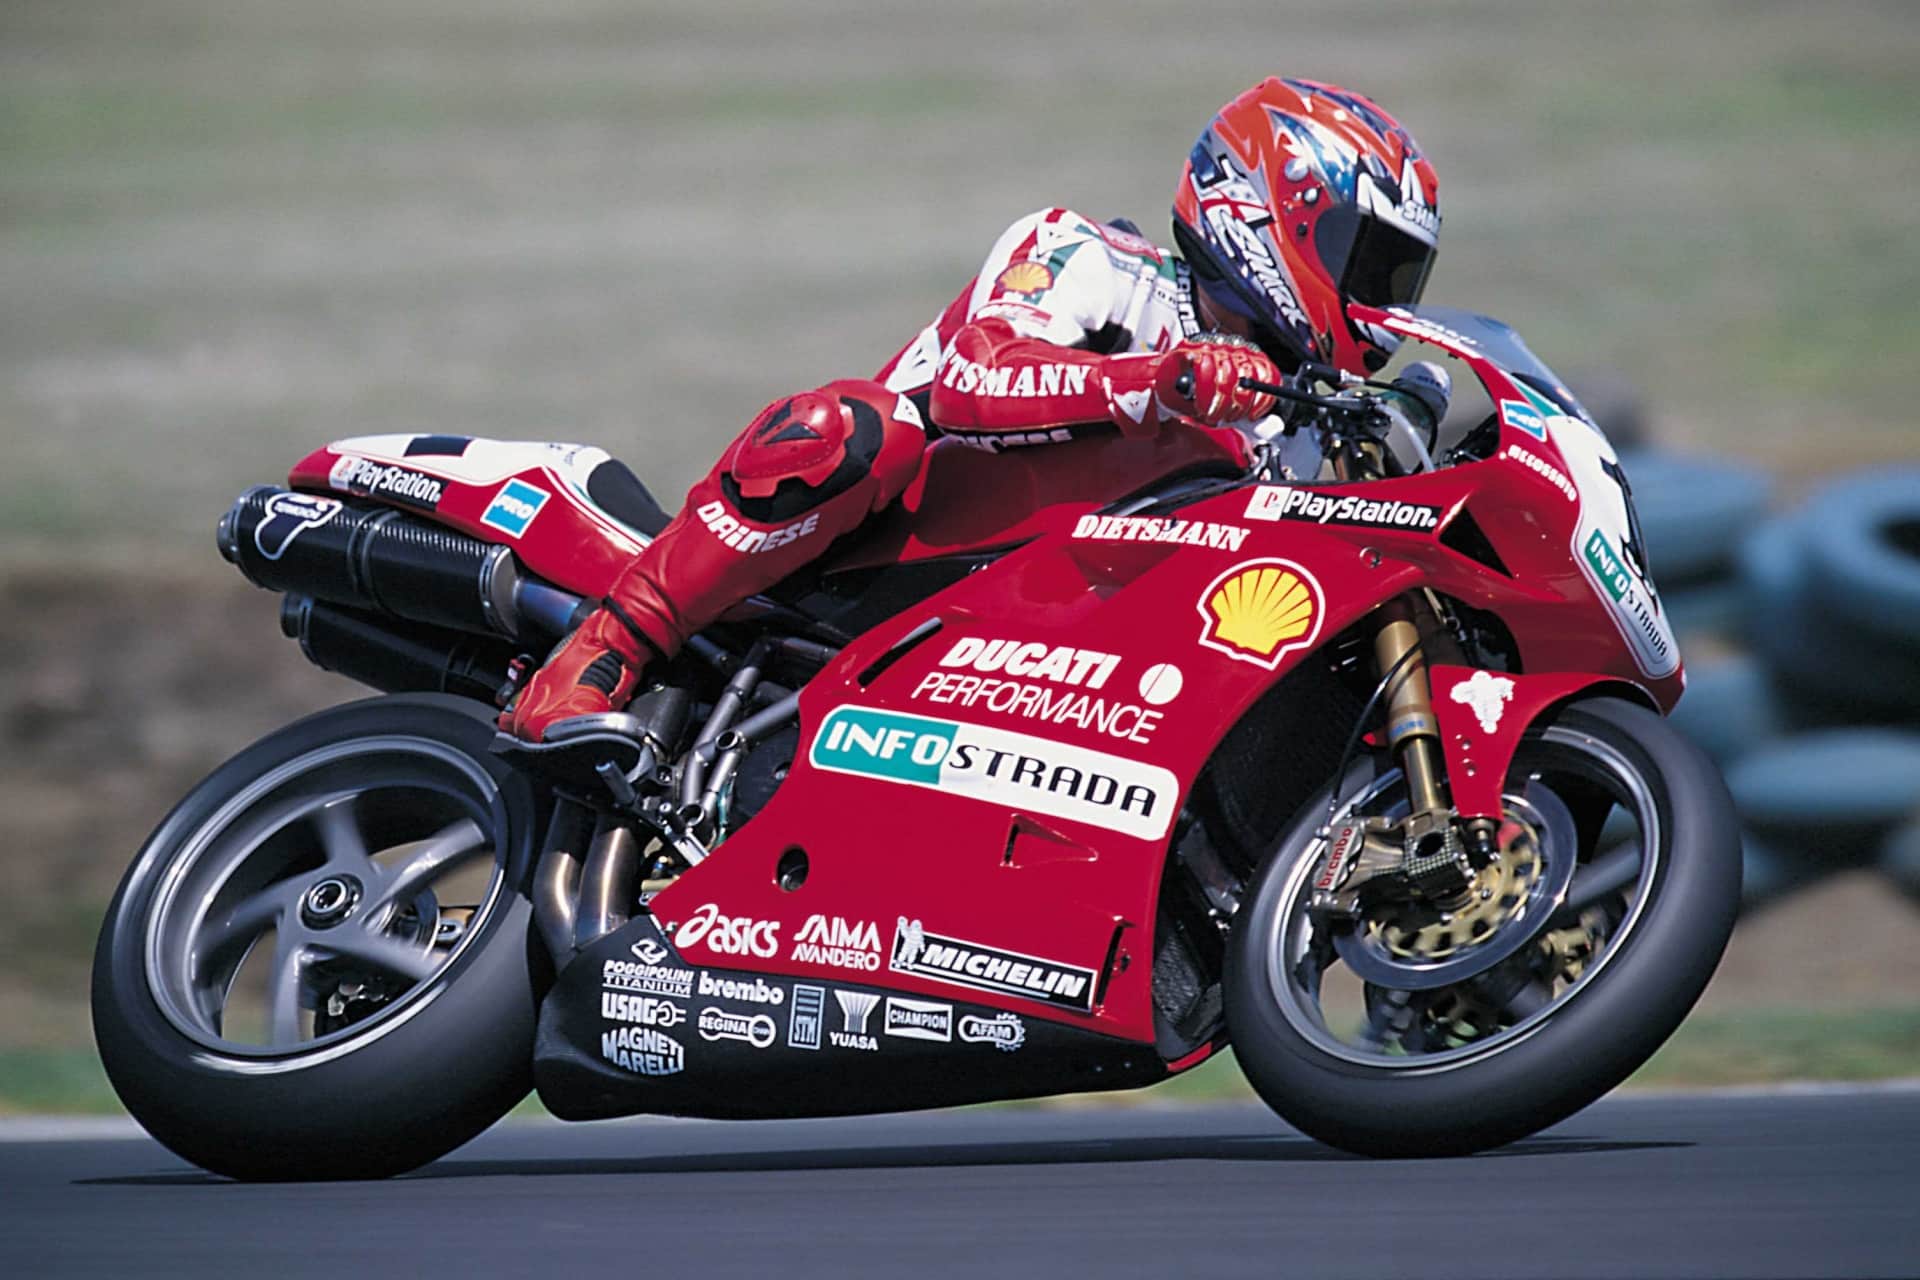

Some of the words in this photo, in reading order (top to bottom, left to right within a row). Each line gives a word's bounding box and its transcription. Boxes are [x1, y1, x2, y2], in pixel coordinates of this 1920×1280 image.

[696, 500, 820, 553] DAINESE
[1072, 514, 1250, 552] DIETSMANN
[939, 637, 1122, 688] DUCATI
[911, 671, 1164, 744] PERFORMANCE
[793, 914, 882, 952] SAIMA
[603, 959, 694, 983] POGGIPOLINI
[791, 945, 880, 971] AVANDERO
[921, 942, 1087, 999] MICHELIN
[604, 974, 693, 996] TITANIUM
[698, 970, 784, 1005] brembo
[602, 992, 659, 1025] USAG
[889, 1008, 948, 1030] CHAMPION
[698, 1014, 748, 1035] REGINA
[794, 1015, 818, 1044] STM
[969, 1022, 1012, 1041] AFAM
[602, 1027, 685, 1066] MAGNETI
[829, 1031, 879, 1051] YUASA
[602, 1046, 685, 1076] MARELLI
